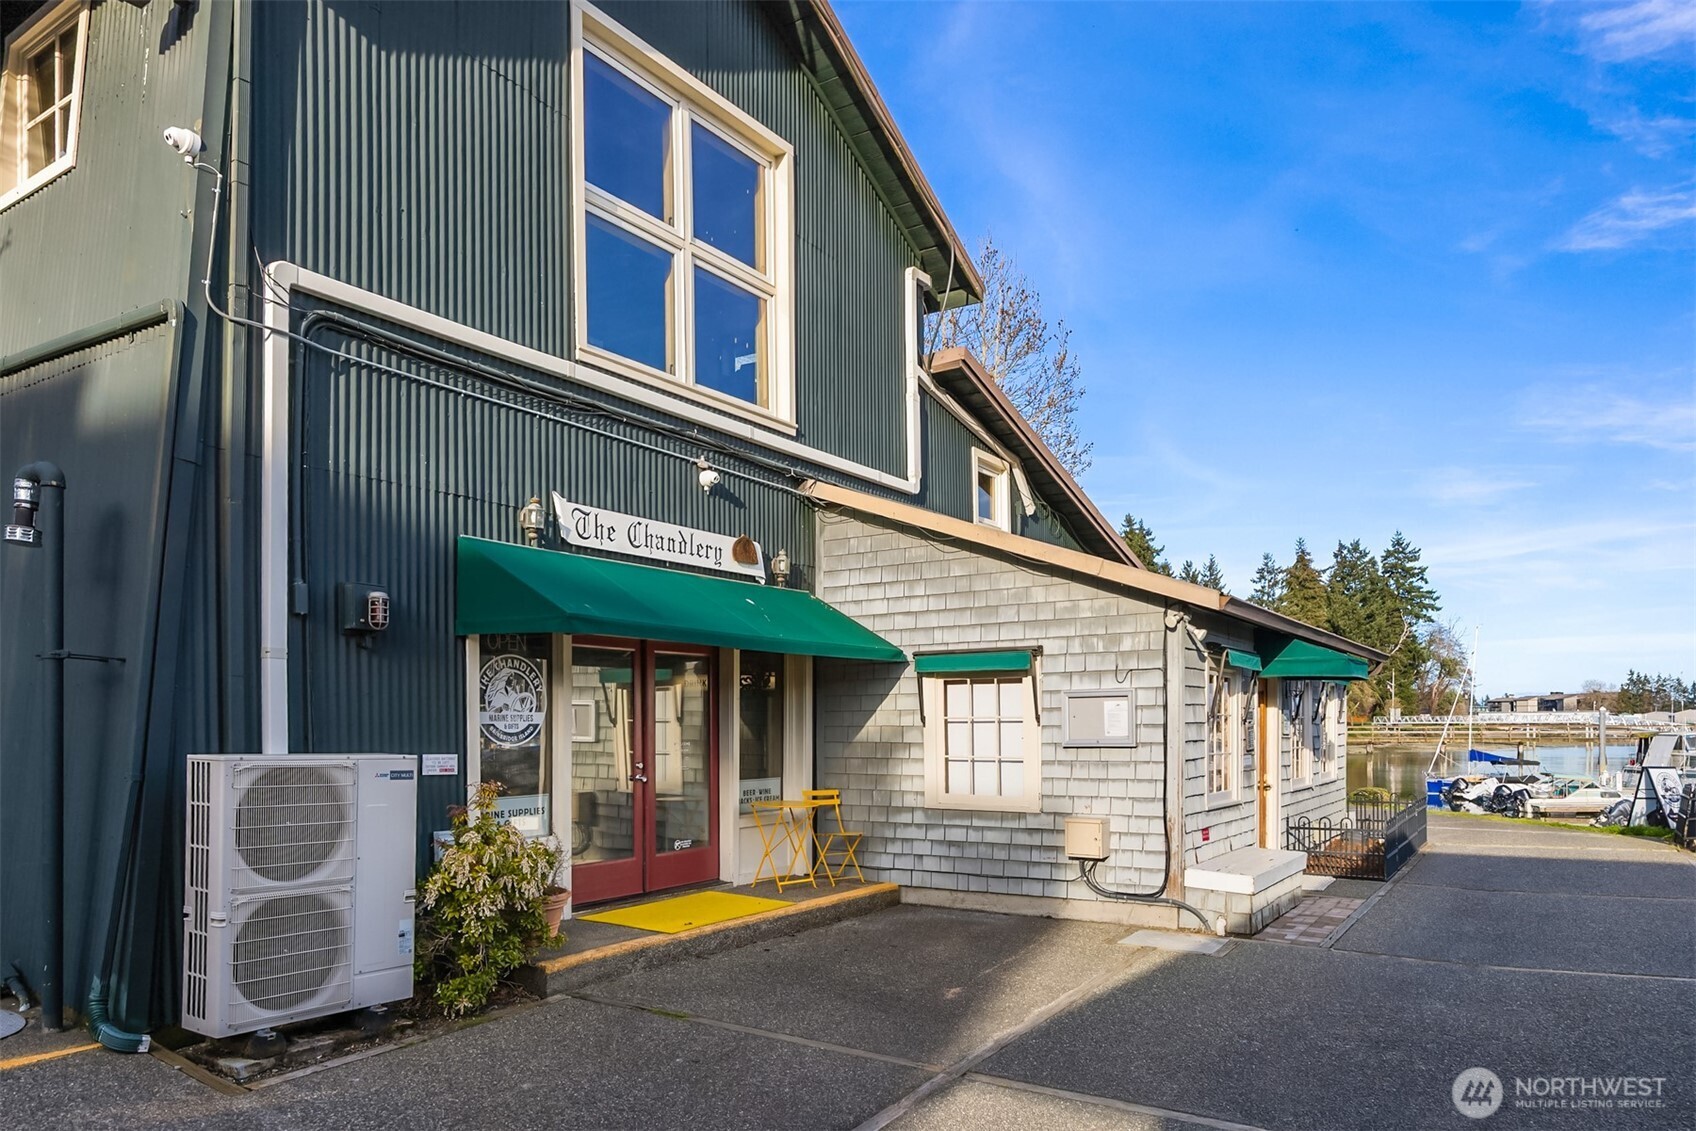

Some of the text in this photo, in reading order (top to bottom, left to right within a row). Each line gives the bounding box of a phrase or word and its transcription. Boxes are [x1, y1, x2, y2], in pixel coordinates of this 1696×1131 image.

[571, 507, 723, 568] The Chandlery
[487, 633, 527, 652] OPEN
[480, 658, 544, 693] THE CHANDLERY
[488, 714, 534, 722] MARINE SUPPLIES
[518, 726, 534, 740] ISLAND
[508, 806, 545, 818] SUPPLIES
